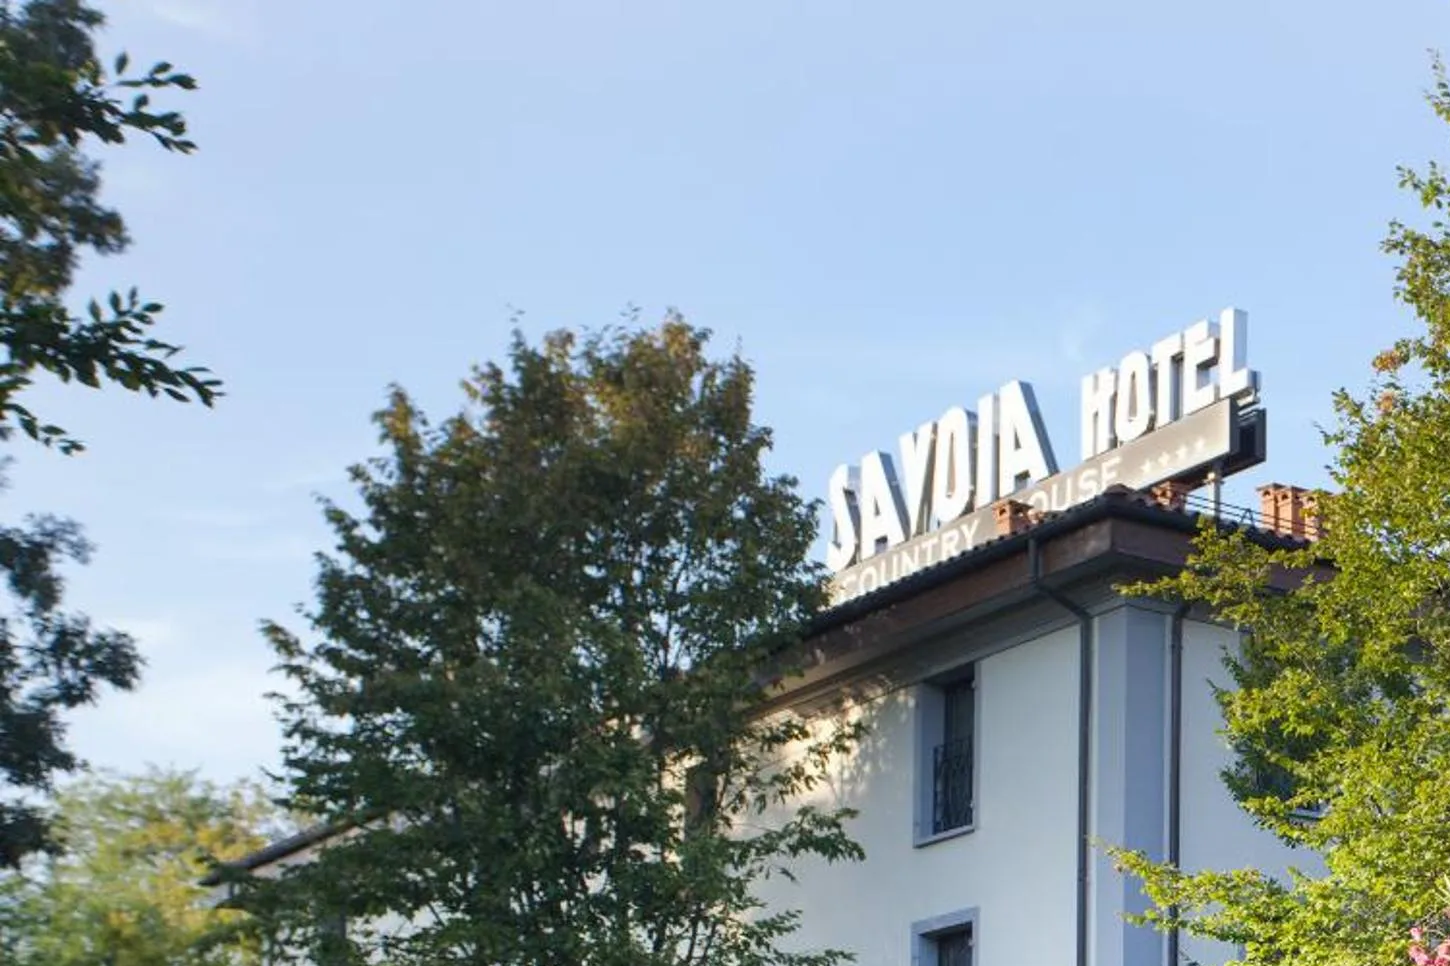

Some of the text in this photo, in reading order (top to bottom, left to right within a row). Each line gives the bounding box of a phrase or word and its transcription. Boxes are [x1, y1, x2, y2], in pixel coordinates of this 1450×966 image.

[827, 308, 1260, 572] SAVOIA HOTEL
[841, 456, 1123, 600] COUNTRY OUSE
